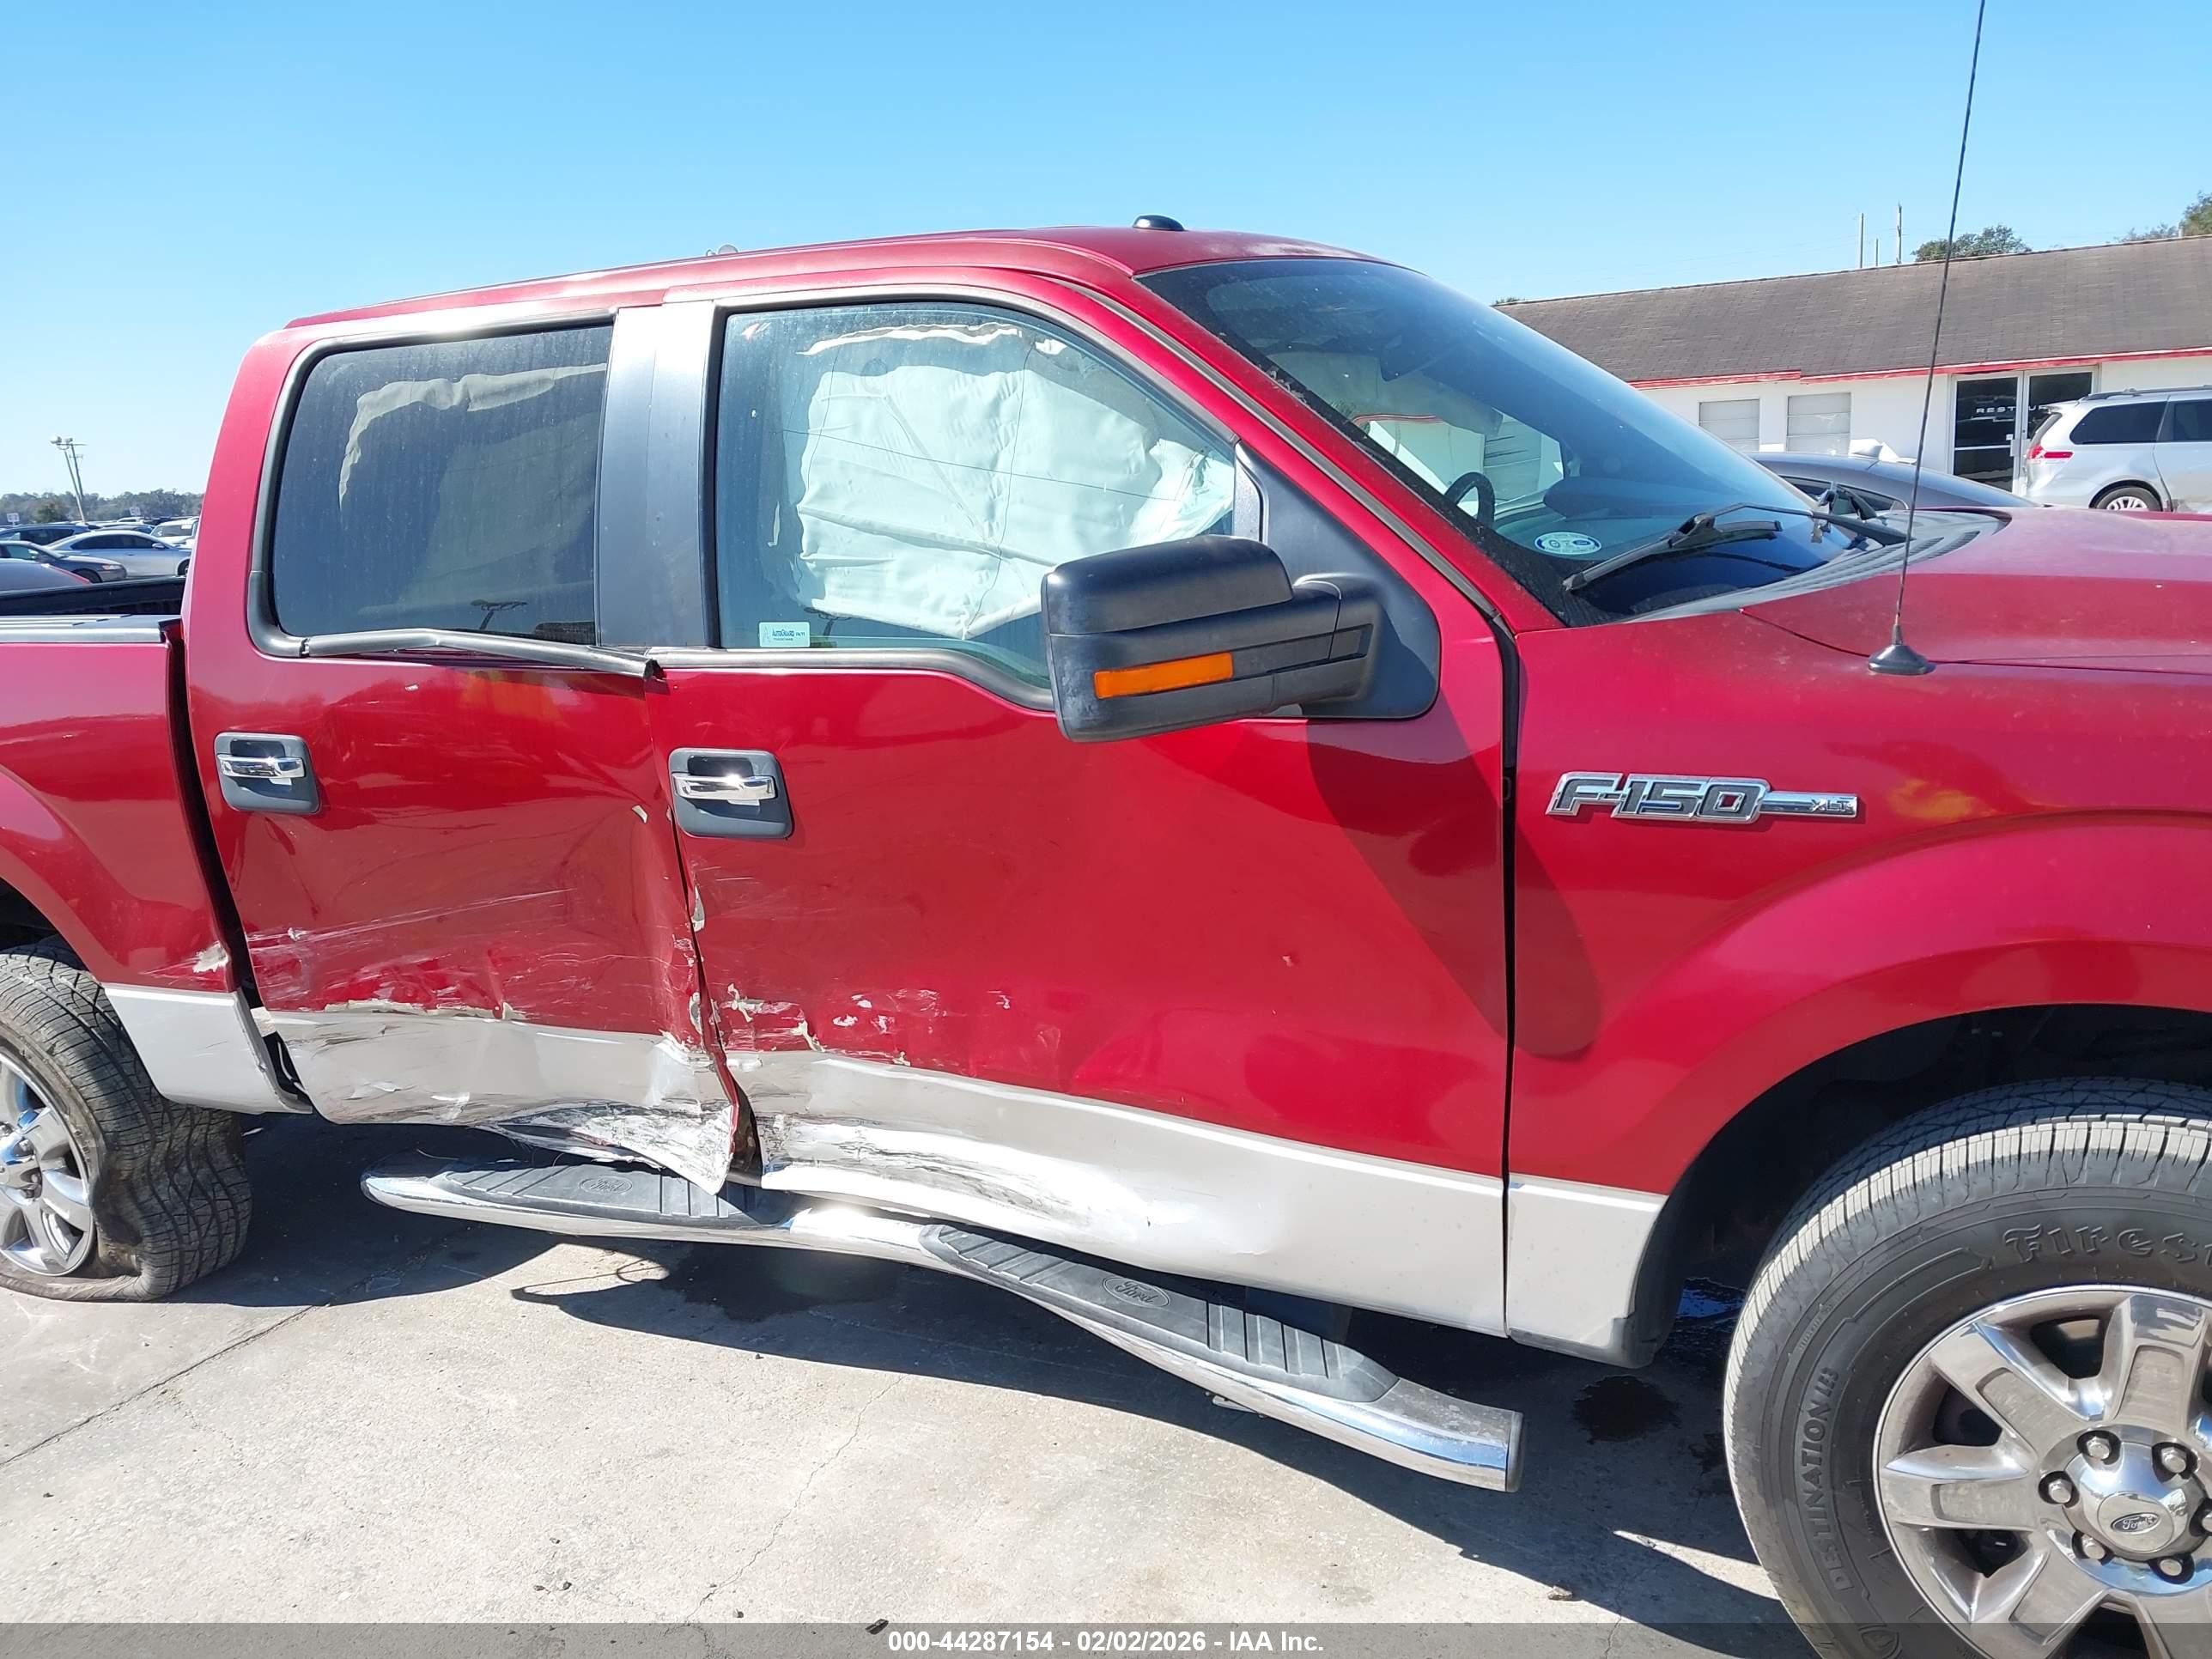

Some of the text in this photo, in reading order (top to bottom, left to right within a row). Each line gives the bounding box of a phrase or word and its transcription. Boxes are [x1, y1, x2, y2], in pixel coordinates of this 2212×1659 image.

[1546, 771, 1856, 824] F-150 XLT
[589, 1178, 626, 1192] Ford
[1114, 1279, 1160, 1304] Ford
[1801, 1399, 1855, 1591] DESTINATION
